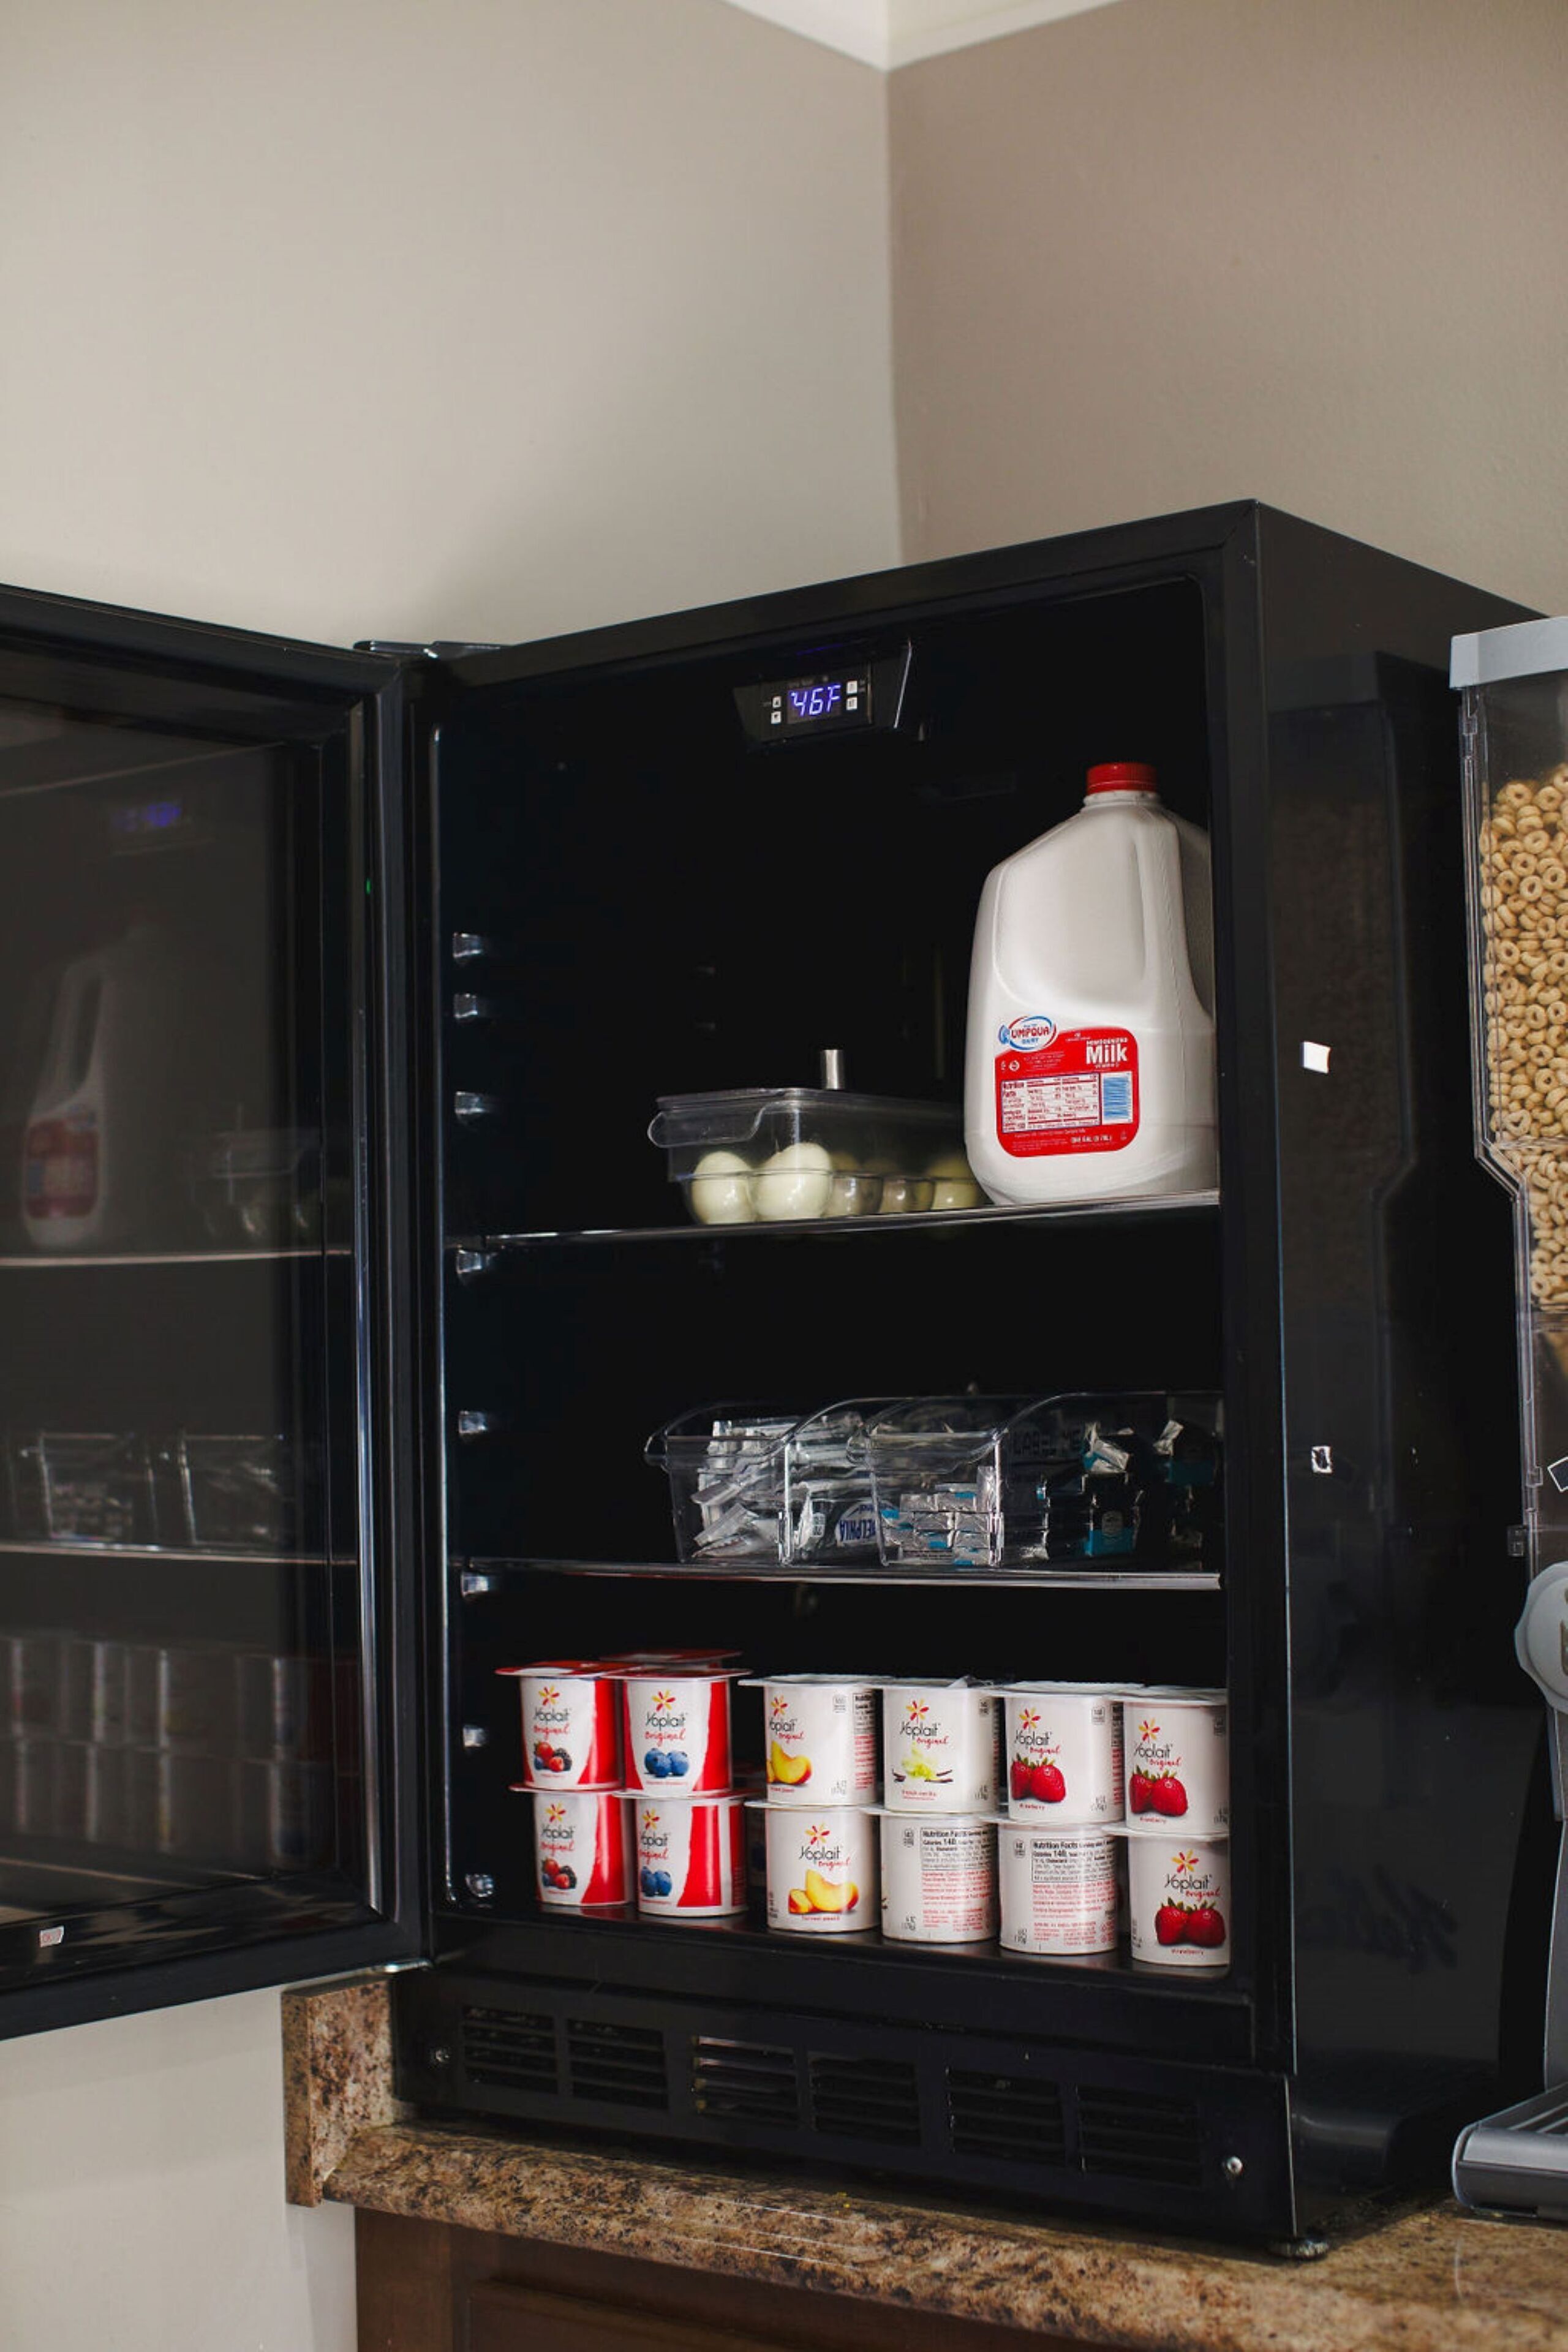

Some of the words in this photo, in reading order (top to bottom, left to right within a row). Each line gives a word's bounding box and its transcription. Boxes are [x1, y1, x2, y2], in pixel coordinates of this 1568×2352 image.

[790, 684, 842, 717] 46F
[1011, 1026, 1049, 1039] UMPQUA
[1086, 1043, 1128, 1065] Milk
[645, 1712, 686, 1731] Yoplait
[900, 1722, 939, 1740] Yoplait
[1014, 1729, 1049, 1749] Yoplait
[799, 1845, 840, 1864] Yoplait
[1164, 1874, 1208, 1893] Yoplait
